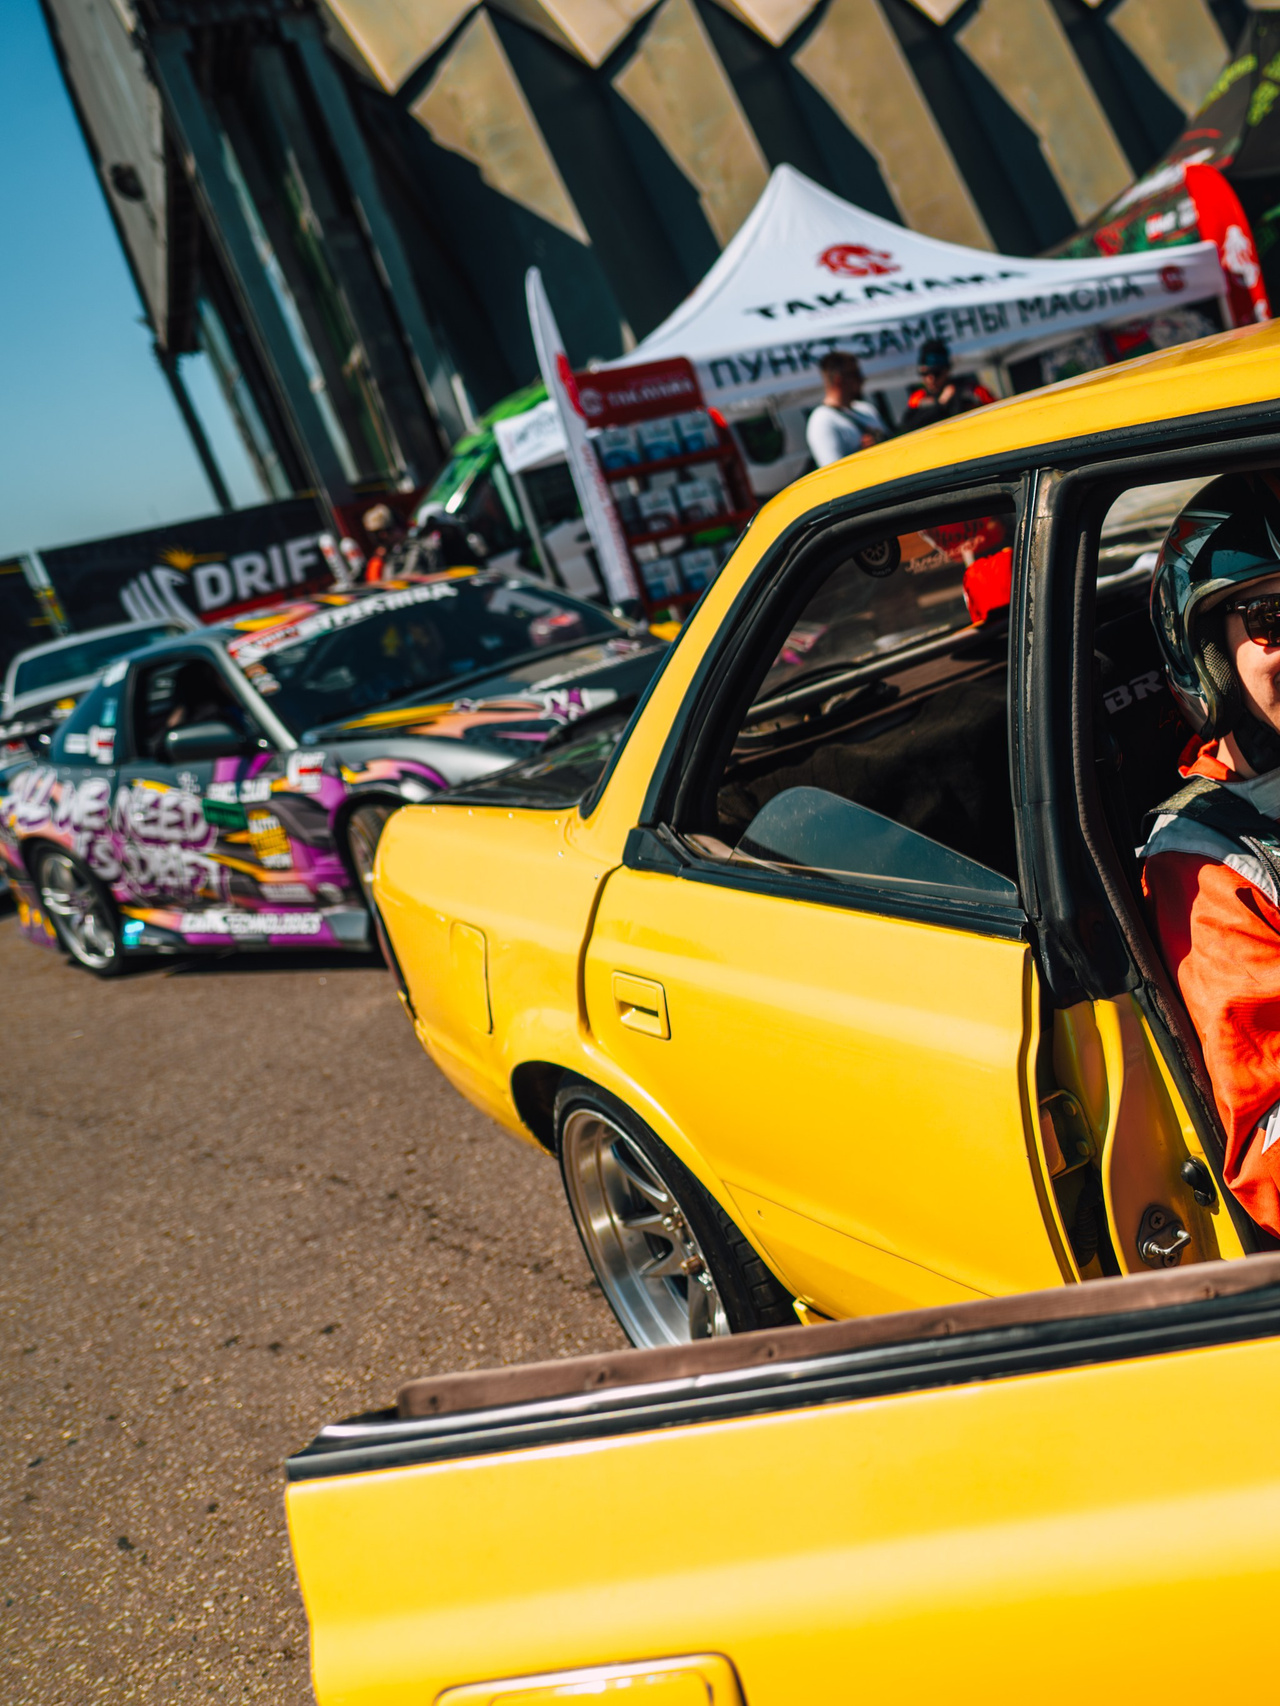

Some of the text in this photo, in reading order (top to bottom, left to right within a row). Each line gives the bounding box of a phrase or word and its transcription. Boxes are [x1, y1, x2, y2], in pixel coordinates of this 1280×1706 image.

[708, 276, 1145, 390] ПУНКТ ЗАМЕНЫ МАСЛА
[744, 270, 1029, 320] TAKAYAMA
[193, 532, 322, 611] DRIF
